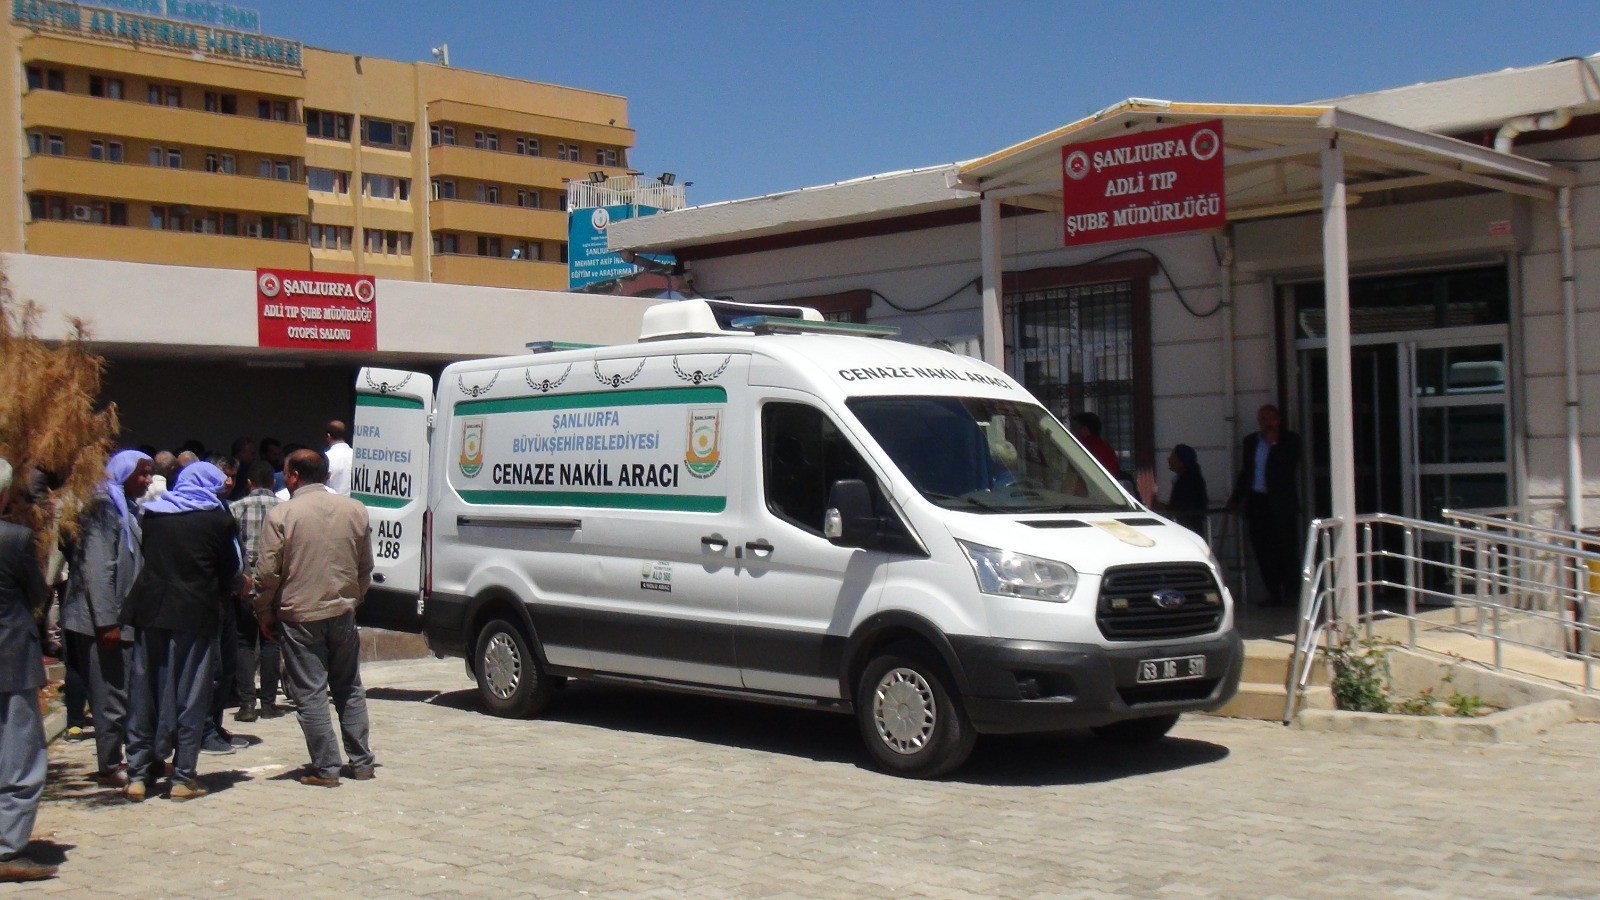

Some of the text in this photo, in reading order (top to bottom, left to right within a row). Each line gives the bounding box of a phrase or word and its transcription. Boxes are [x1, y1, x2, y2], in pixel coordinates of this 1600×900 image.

[1093, 139, 1187, 173] ŞANLIURFA
[1105, 171, 1177, 197] ADLİ TIP
[1067, 193, 1220, 237] ŞUBE MÜDÜRLÜĞÜ
[574, 259, 599, 267] MEHMET
[283, 279, 354, 297] ŞANLIURFA
[264, 303, 372, 322] ADLİ TIP ŞUBE MÜDÜRLÜĞÜ
[287, 325, 351, 340] OTOPSİ SALONU
[838, 366, 1013, 390] CENAZE NAKİL ARACI
[552, 411, 620, 433] ŞANLIURFA
[513, 430, 660, 456] BÜYÜKŞEHİR BELEDİYESİ
[355, 447, 412, 463] BELEDİYESİ
[374, 470, 412, 497] ARACI
[492, 463, 555, 485] CENAZE
[560, 459, 613, 486] NAKİL
[618, 463, 679, 488] ARACI
[378, 520, 402, 539] ALO
[377, 540, 400, 560] 188
[1143, 662, 1158, 680] 63
